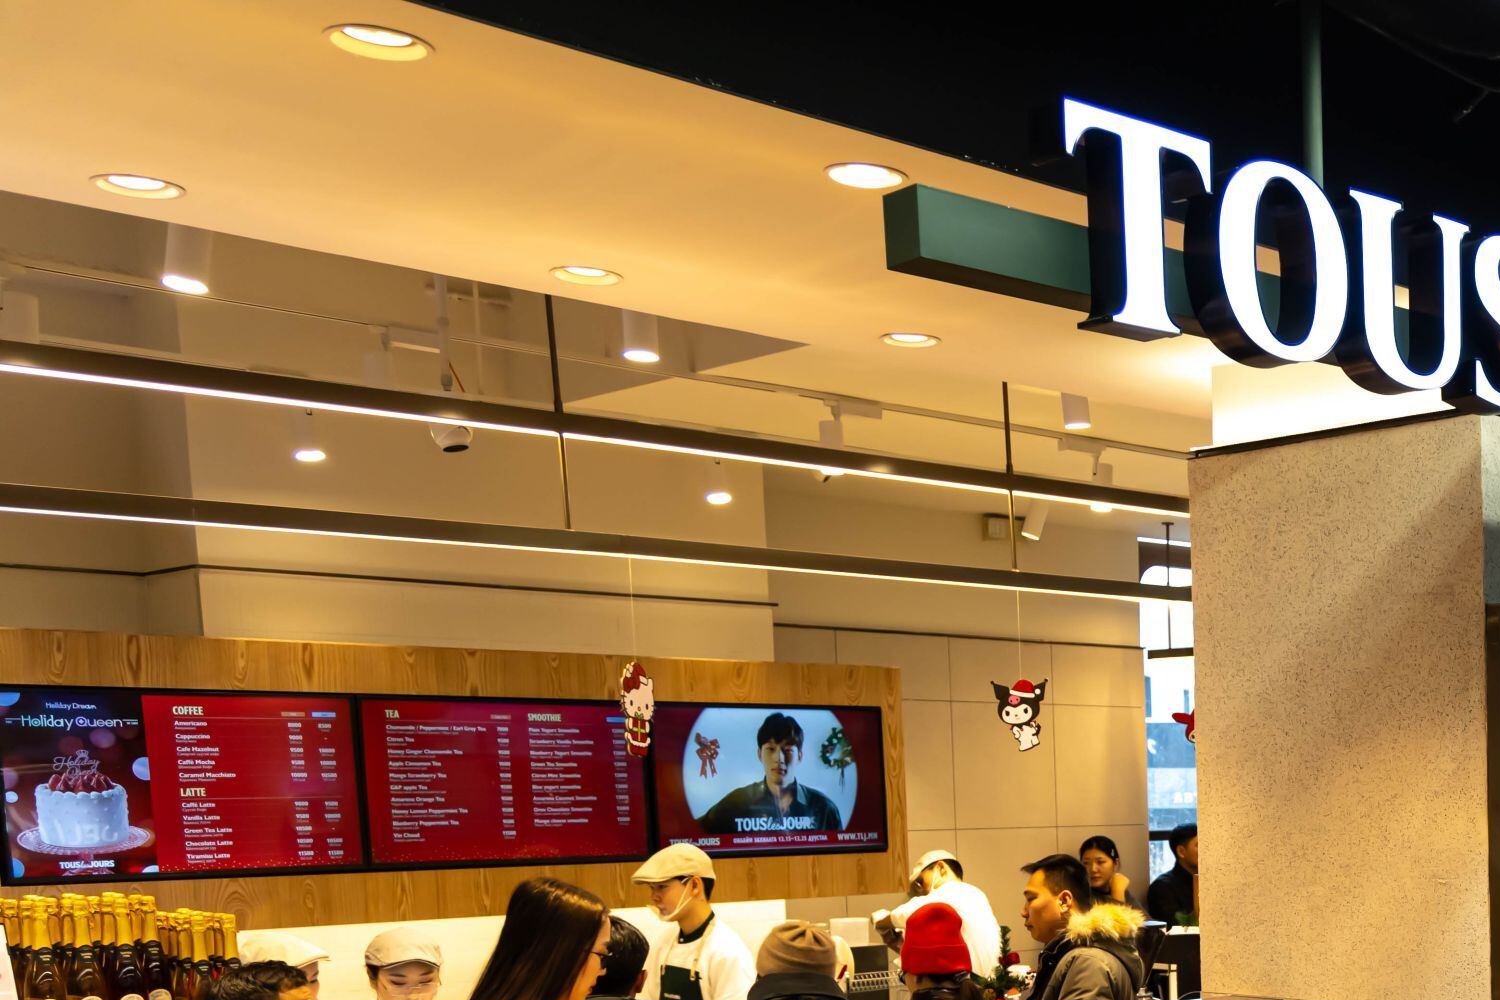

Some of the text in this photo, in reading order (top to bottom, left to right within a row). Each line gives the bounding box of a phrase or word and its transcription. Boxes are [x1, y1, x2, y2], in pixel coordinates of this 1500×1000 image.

[172, 706, 204, 716] COFFEE
[384, 709, 399, 718] TEA
[21, 714, 74, 730] Holiday
[75, 716, 123, 728] Queen
[528, 713, 561, 722] SMOOTHIE
[180, 788, 207, 797] LATTE
[735, 818, 767, 831] TOUS
